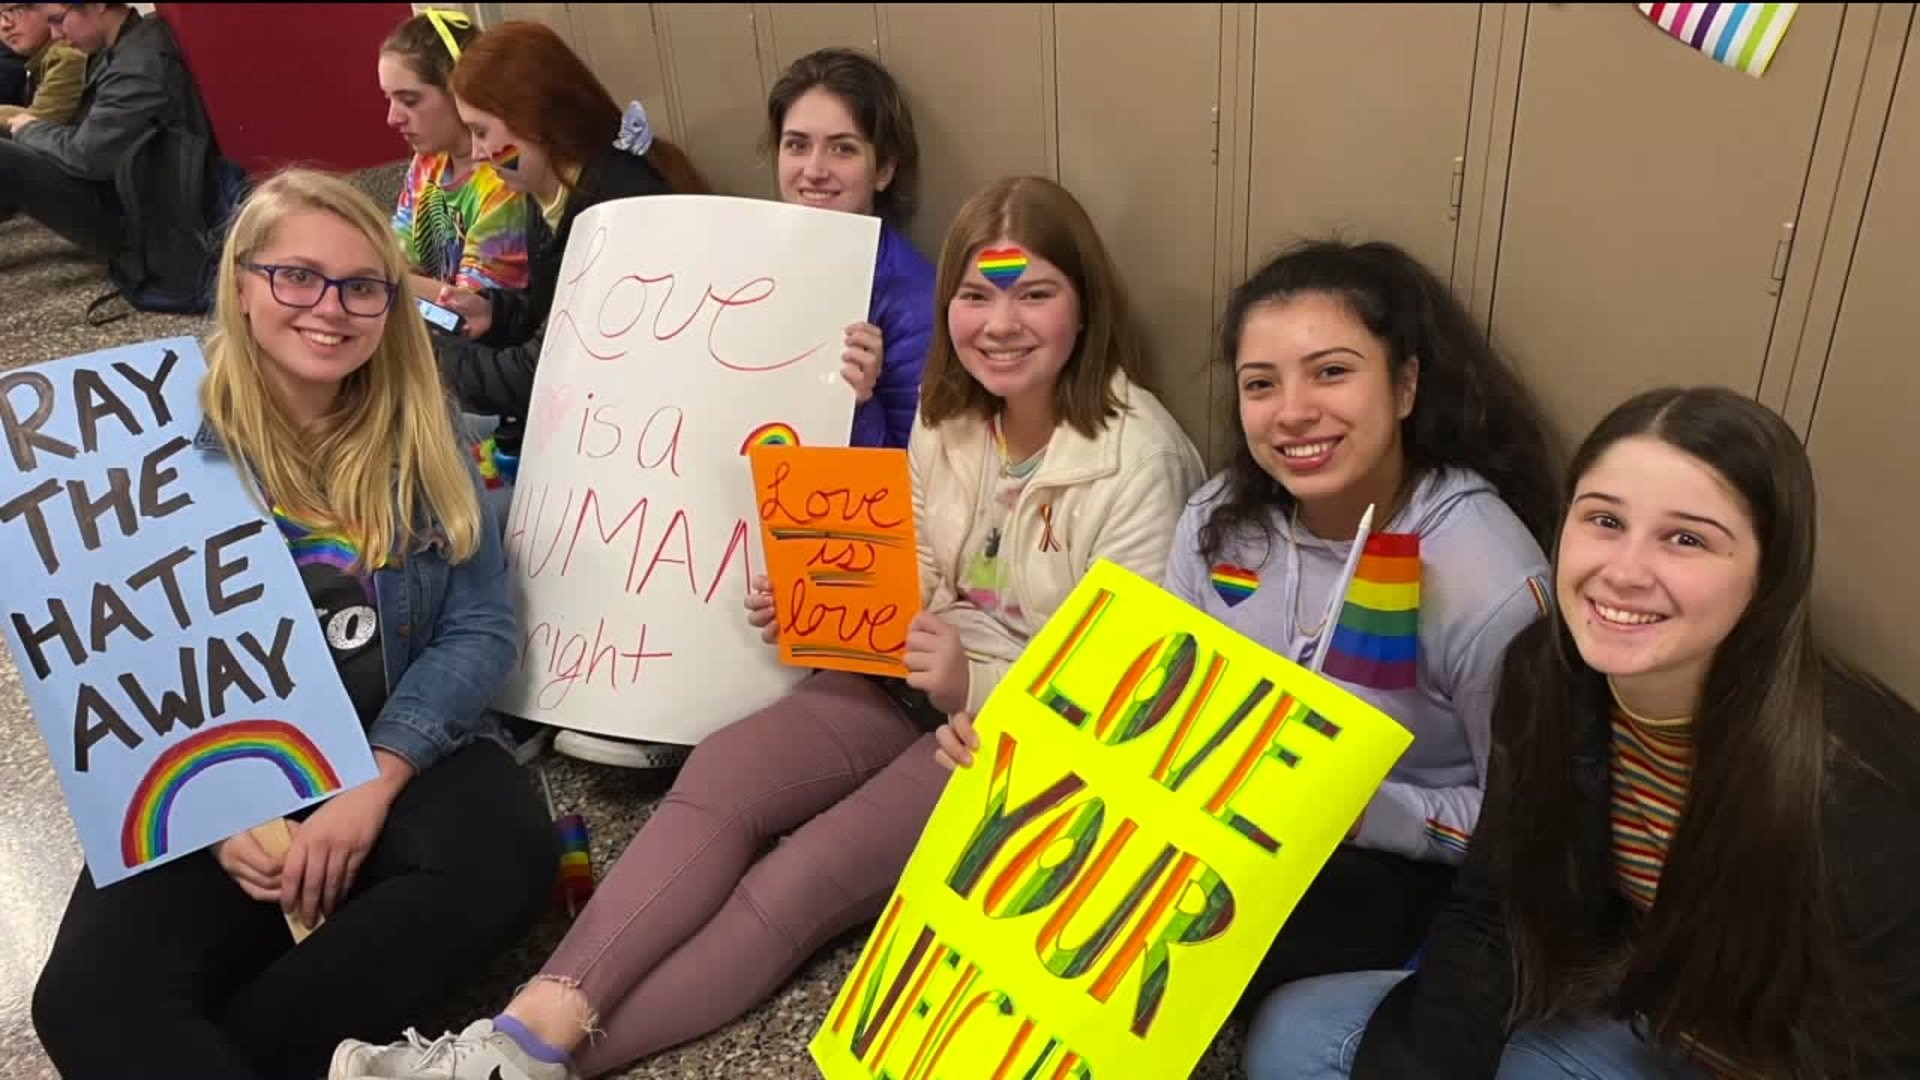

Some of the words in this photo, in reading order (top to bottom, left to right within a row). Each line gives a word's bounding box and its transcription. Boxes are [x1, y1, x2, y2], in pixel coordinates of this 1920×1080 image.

[545, 227, 828, 371] Love
[0, 349, 179, 471] RAY
[576, 392, 623, 458] is
[637, 404, 681, 478] a
[0, 436, 194, 574] THE
[760, 461, 905, 529] Love
[806, 541, 876, 572] is
[11, 519, 268, 681] HATE
[520, 617, 673, 711] right
[783, 578, 907, 654] love
[75, 617, 296, 773] AWAY
[1025, 588, 1343, 857] LOVE
[944, 731, 1237, 1040] YOUR
